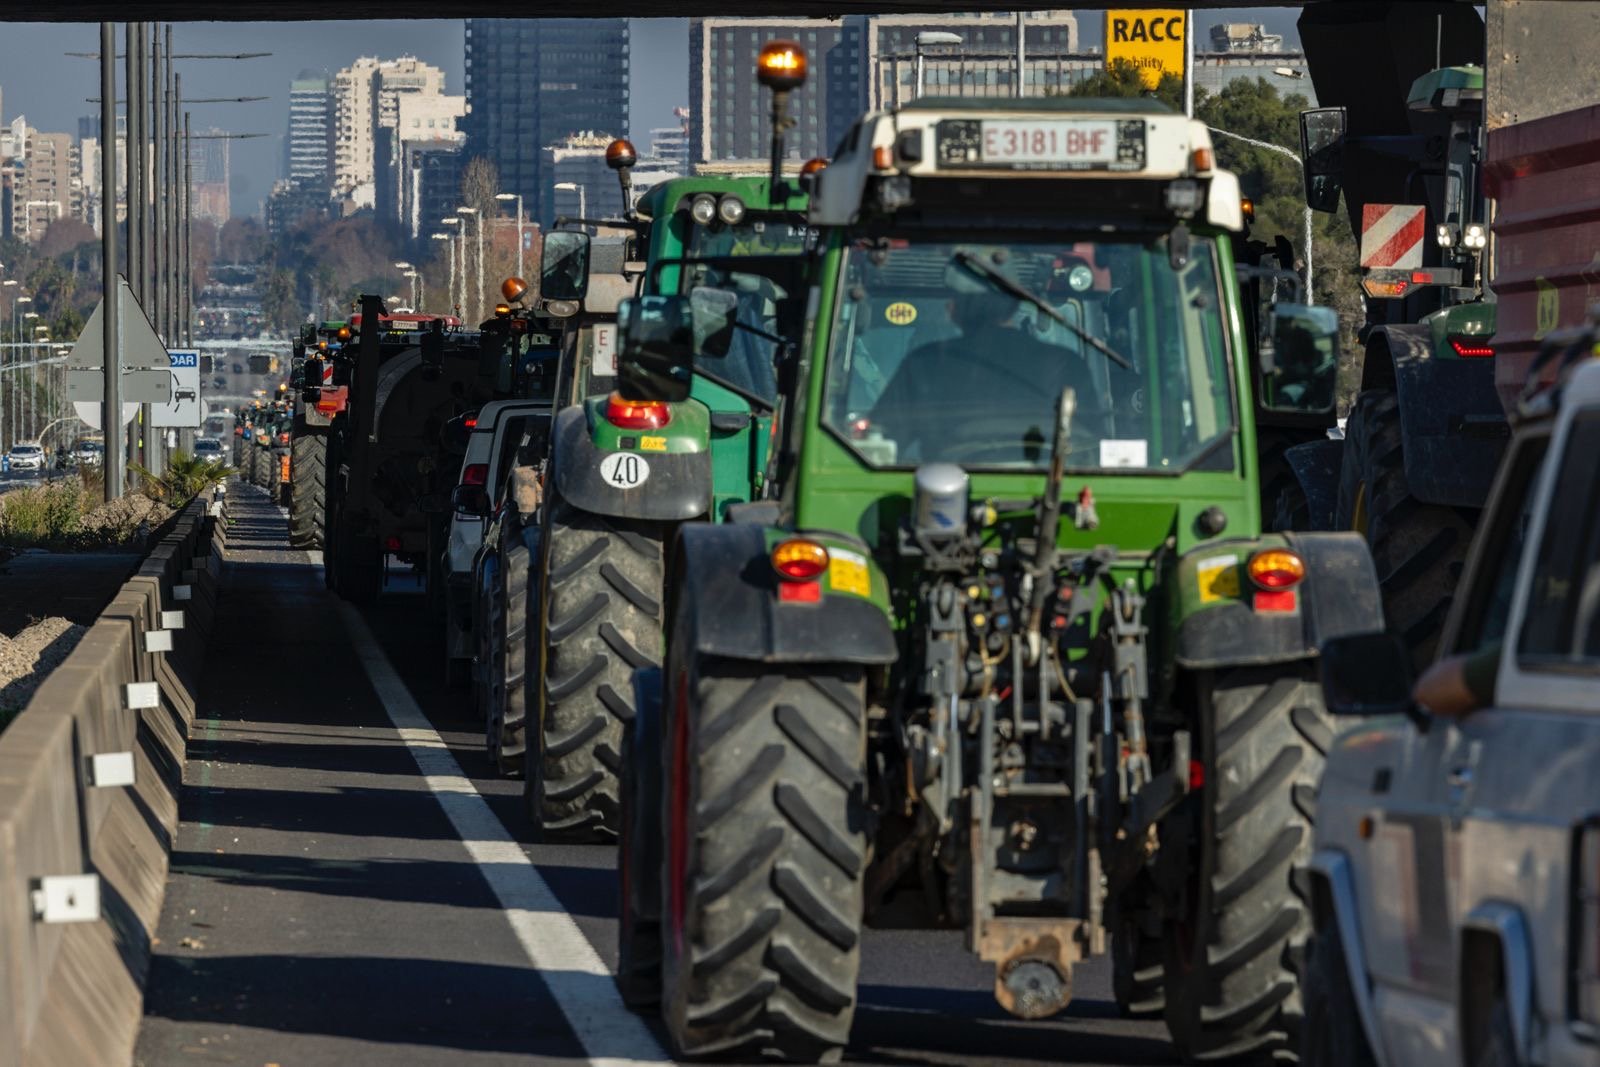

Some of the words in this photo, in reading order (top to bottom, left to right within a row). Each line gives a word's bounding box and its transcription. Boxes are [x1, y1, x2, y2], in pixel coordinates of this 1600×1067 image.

[1113, 16, 1182, 42] RACC
[986, 128, 998, 155] E
[1003, 129, 1057, 155] 3181
[612, 456, 639, 484] 40
